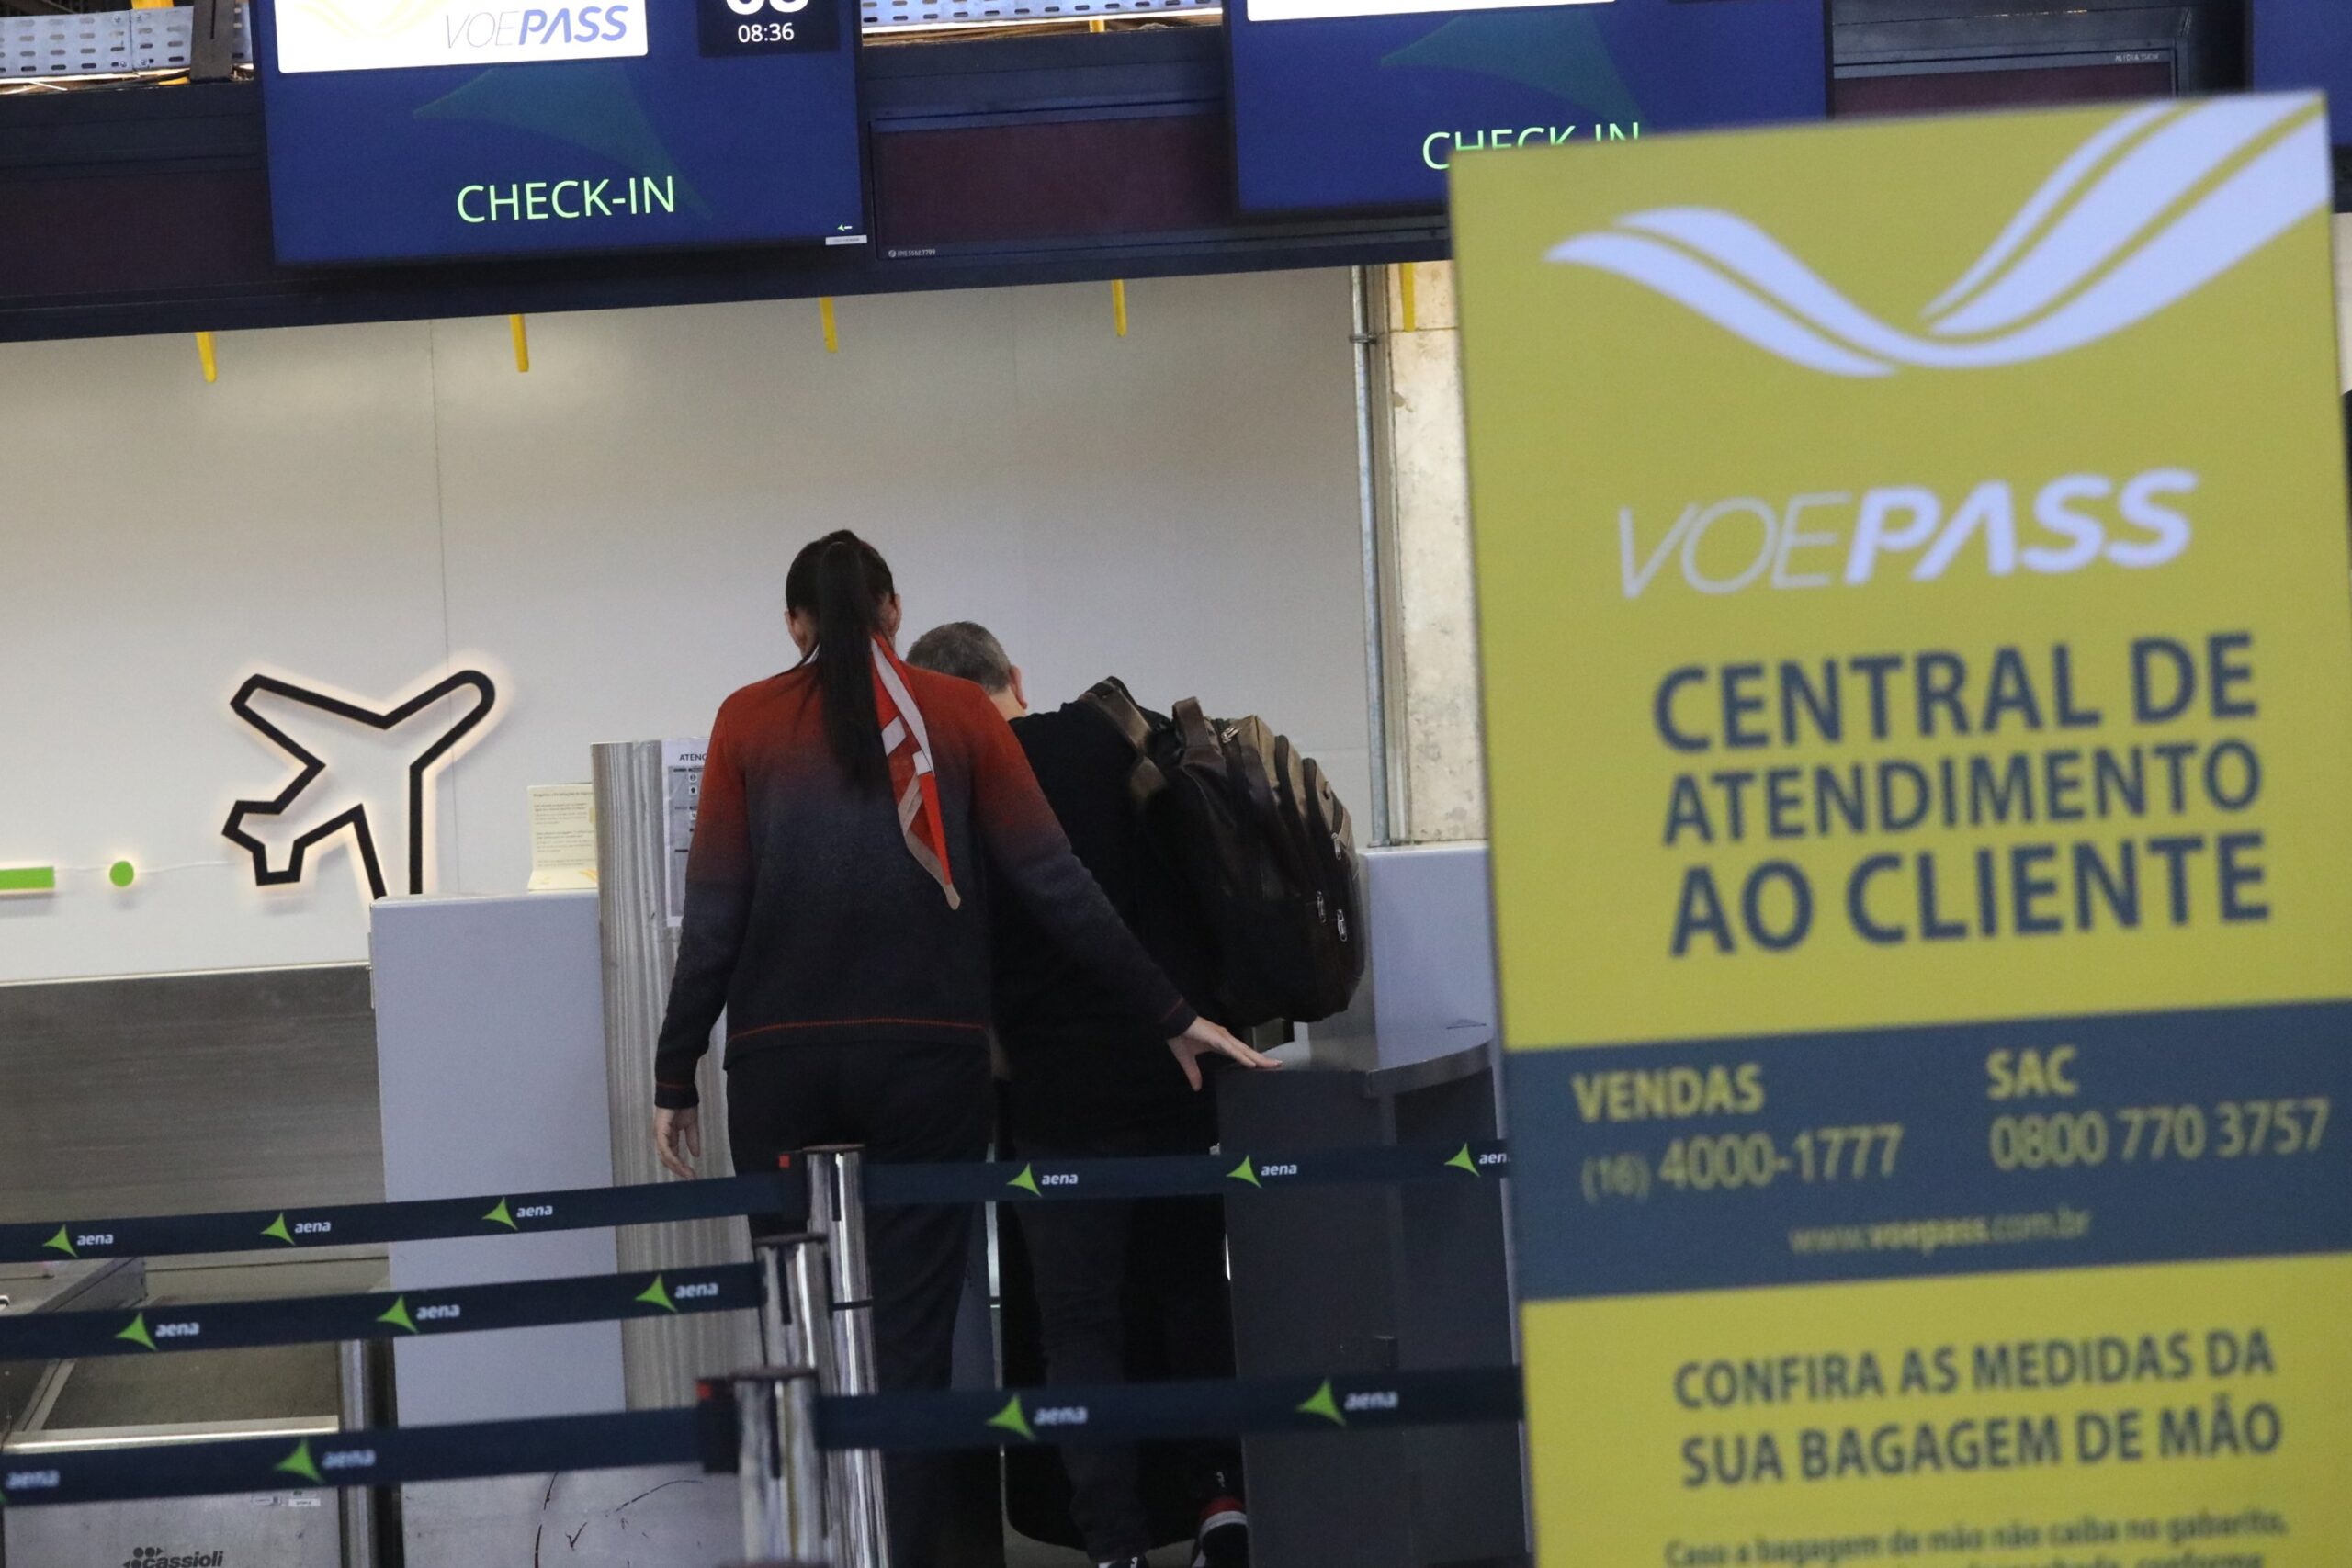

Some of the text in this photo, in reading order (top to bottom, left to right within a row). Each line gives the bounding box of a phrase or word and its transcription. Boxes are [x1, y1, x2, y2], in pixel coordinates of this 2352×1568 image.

[446, 5, 629, 48] VOEPASS
[738, 22, 795, 43] 08:36
[458, 176, 674, 222] CHECK-IN
[1618, 467, 2199, 599] VOEPASS
[1655, 632, 2258, 752] CENTRAL DE
[1664, 739, 2263, 846] ATENDIMENTO
[1670, 831, 2270, 957] AO CLIENTE
[1986, 1044, 2077, 1100] SAC
[1571, 1063, 1765, 1122] VENDAS
[1990, 1097, 2330, 1170] 0800 770 3757
[1479, 1153, 1510, 1165] aen
[1658, 1122, 1905, 1189] 4000-1777
[1042, 1173, 1079, 1185] aena
[1261, 1164, 1297, 1176] aena
[517, 1205, 553, 1218] aena
[295, 1221, 331, 1233] aena
[77, 1234, 114, 1246] aena
[675, 1282, 719, 1299] aena
[416, 1304, 460, 1320] aena
[155, 1322, 200, 1337] aena
[1674, 1329, 2275, 1409] CONFIRA AS MEDIDAS DA
[1344, 1391, 1398, 1409] aena
[1034, 1406, 1088, 1425] aena
[1681, 1394, 2282, 1487] SUA BAGAGEM DE MÃO
[323, 1450, 376, 1469] aena
[6, 1470, 60, 1489] aena
[142, 1551, 224, 1568] cassioli
